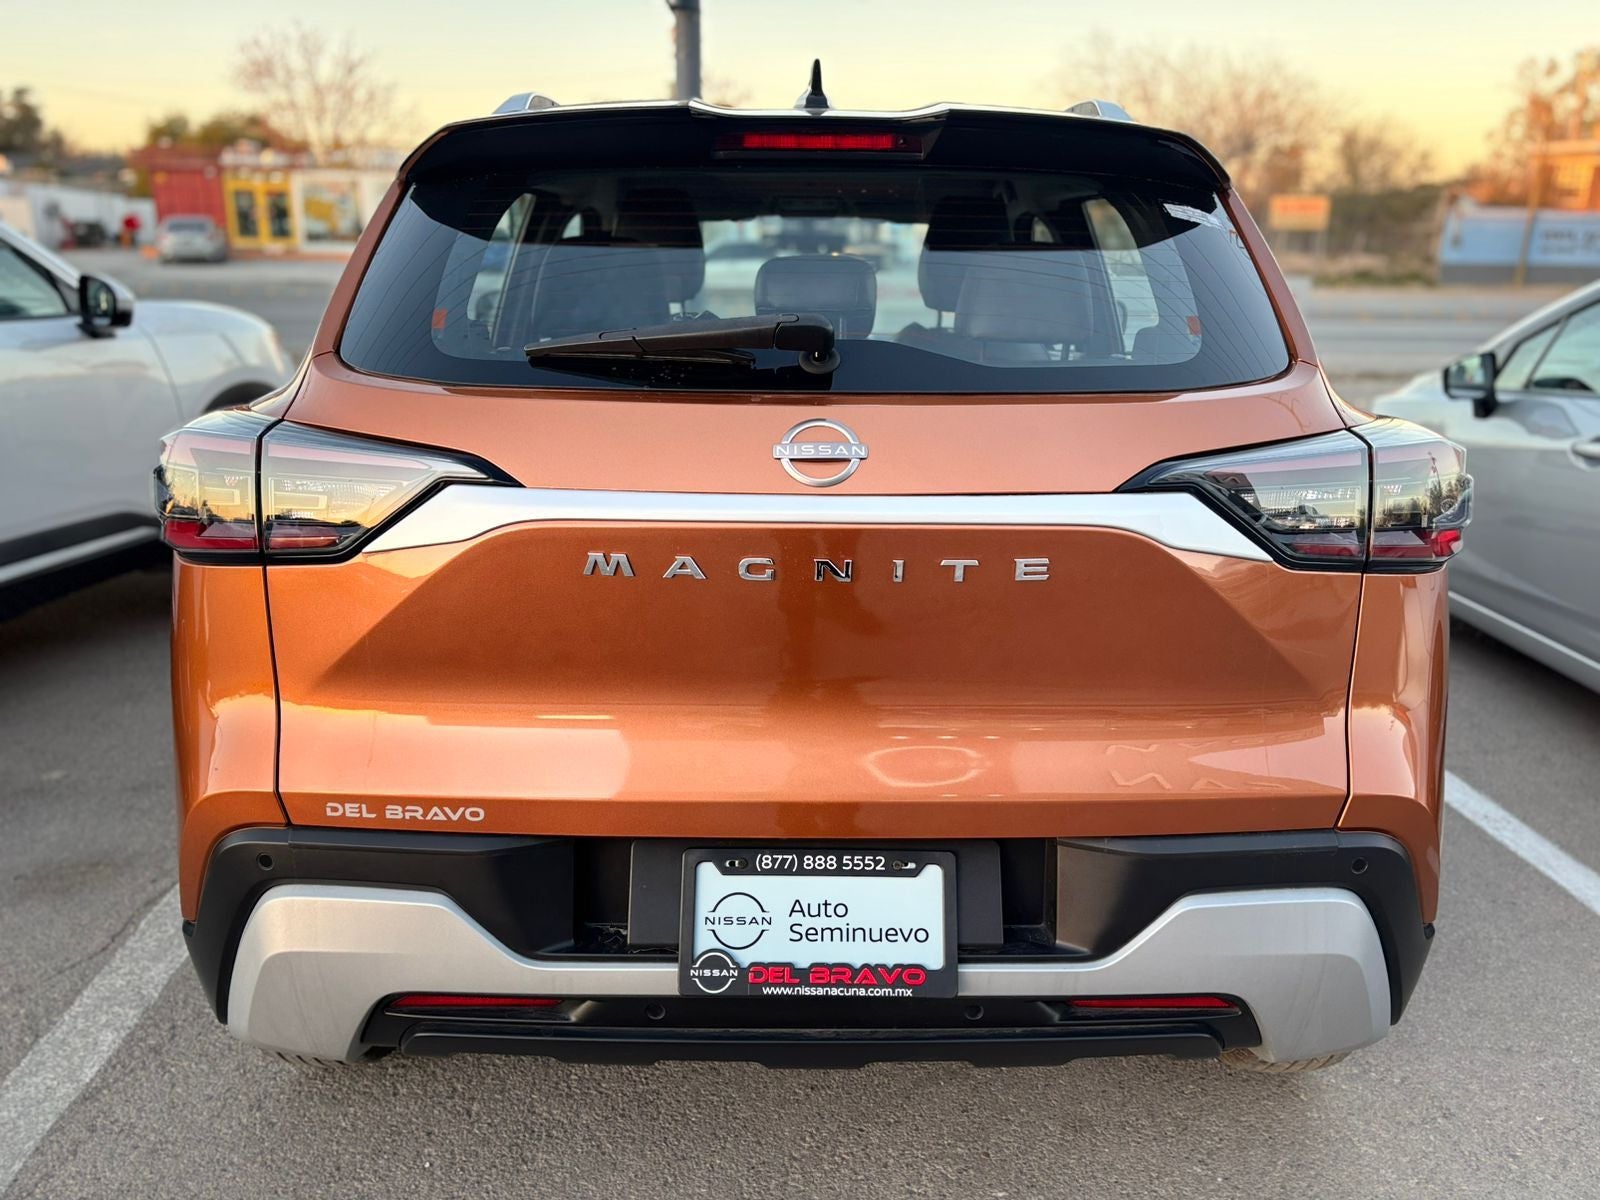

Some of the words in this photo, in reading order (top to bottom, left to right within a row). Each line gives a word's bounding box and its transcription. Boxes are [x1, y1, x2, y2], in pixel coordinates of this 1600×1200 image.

[776, 444, 866, 456] NISSAN
[583, 552, 1050, 582] MAGNITE
[325, 802, 377, 818] DEL
[385, 805, 485, 822] BRAVO
[755, 853, 798, 872] (877)
[803, 855, 837, 870] 888
[842, 855, 886, 871] 5552
[788, 899, 849, 918] Auto
[704, 916, 772, 926] NISSAN
[788, 923, 930, 944] Seminuevo
[690, 969, 738, 977] NISSAN
[748, 966, 800, 984] DEL
[809, 967, 927, 986] BRAVO
[762, 985, 913, 998] www.nissanacuna.com.mx
